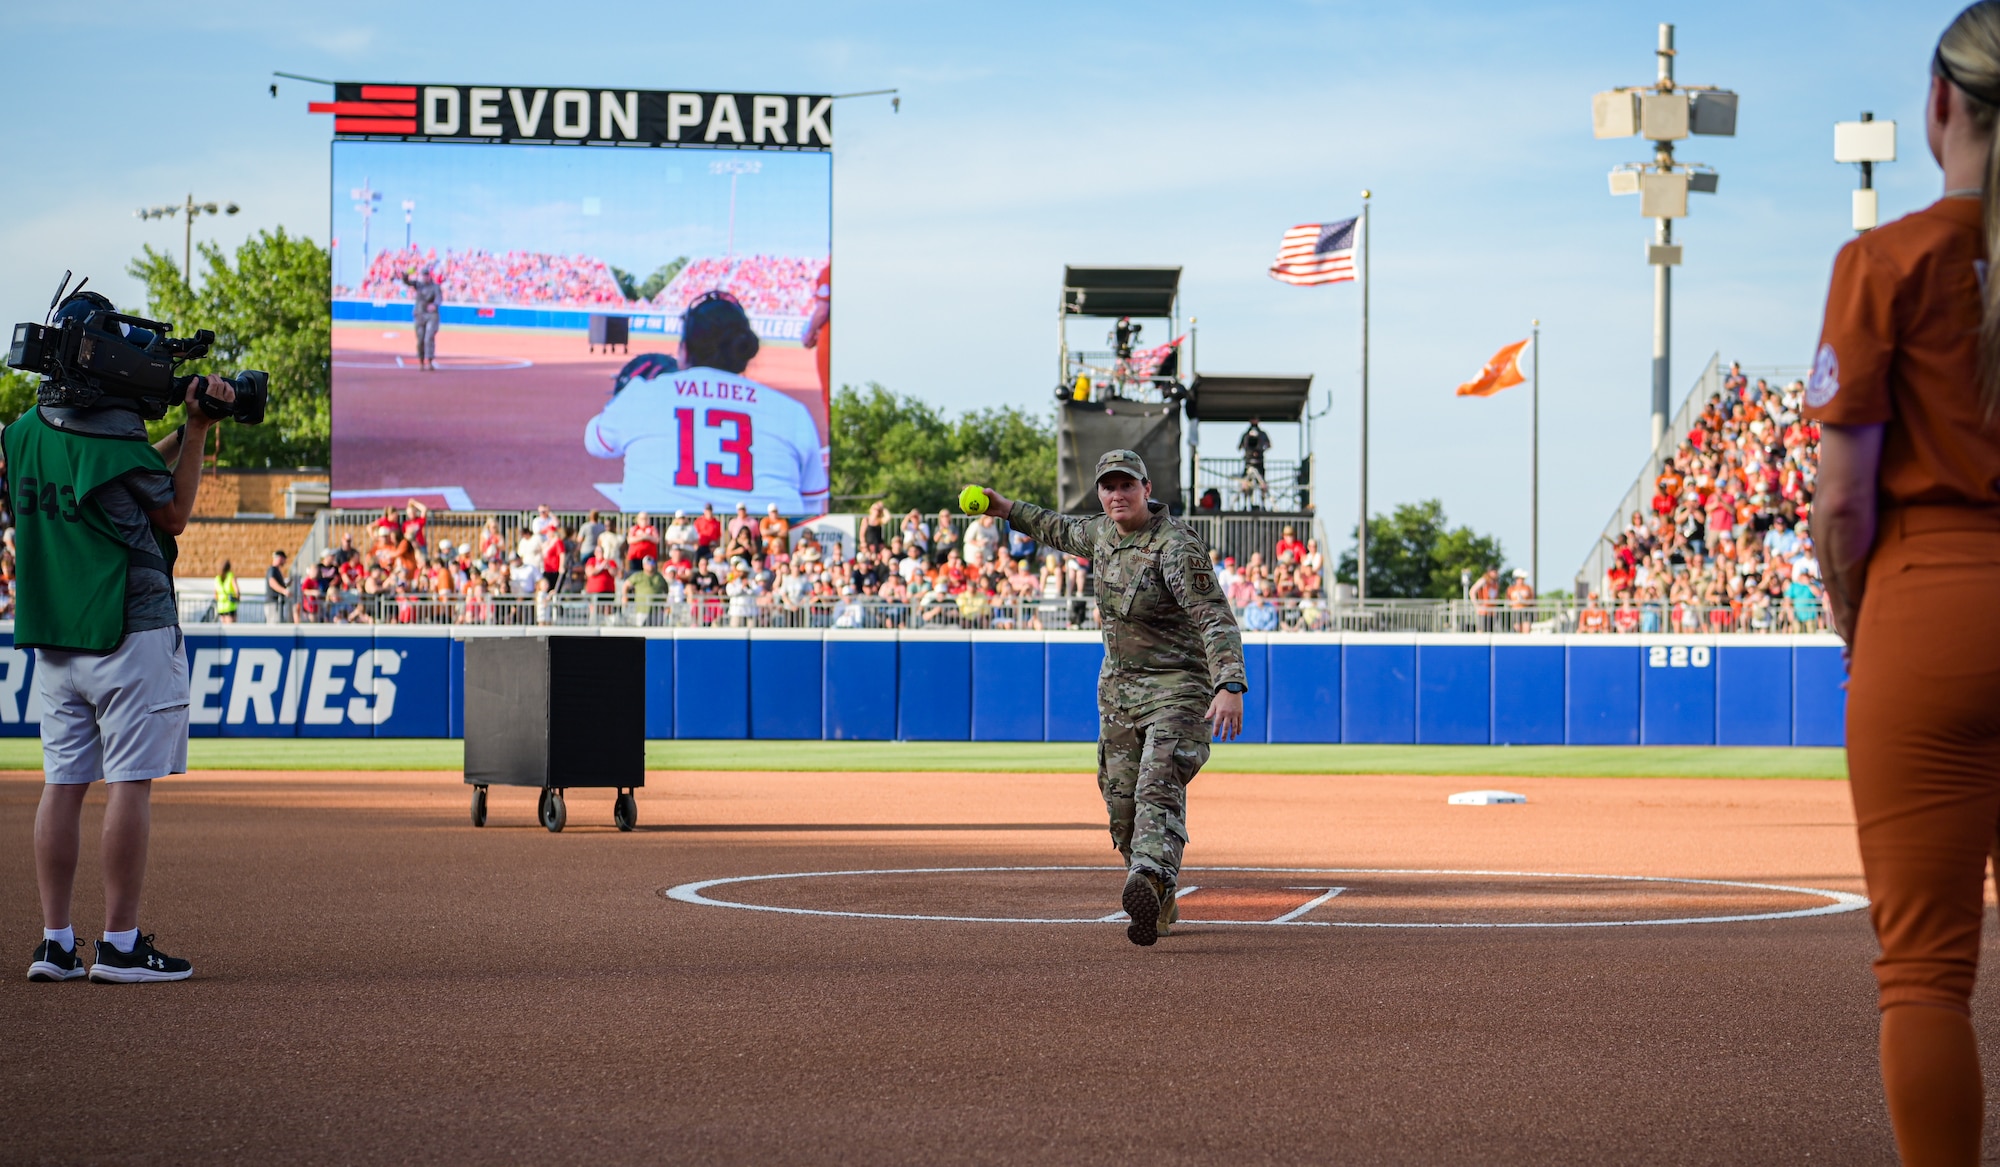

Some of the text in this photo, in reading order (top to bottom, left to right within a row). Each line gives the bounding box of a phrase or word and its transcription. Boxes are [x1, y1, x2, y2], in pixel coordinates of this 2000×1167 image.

[423, 86, 832, 144] DEVON PARK
[752, 319, 803, 339] OLLEGE
[673, 379, 757, 403] VALDEZ
[673, 406, 754, 493] 13
[16, 476, 82, 523] 543
[1190, 558, 1210, 570] MX
[1648, 646, 1711, 668] 220
[189, 648, 401, 725] ERIES
